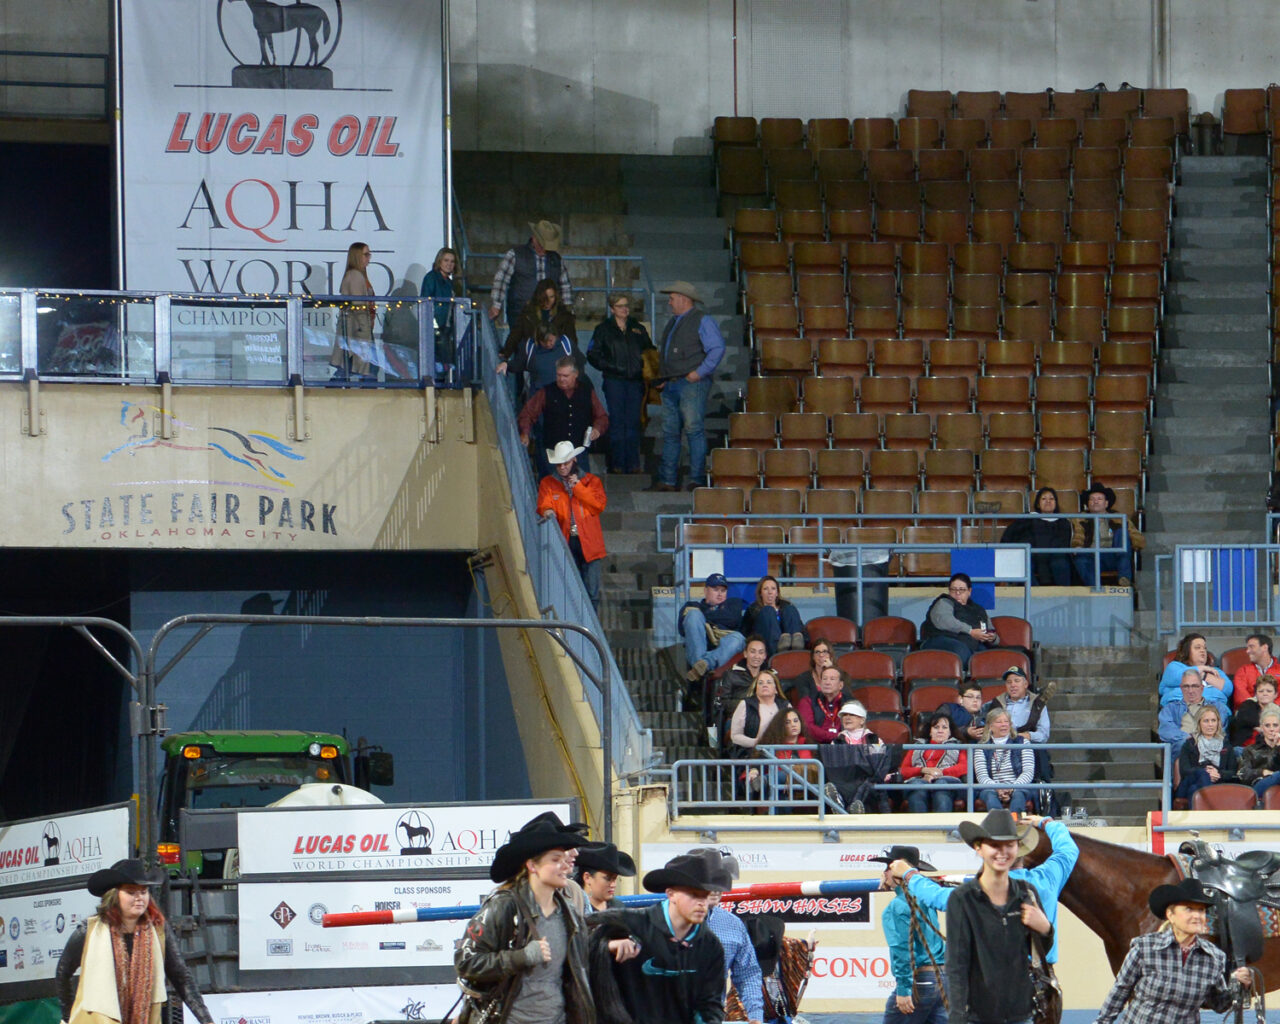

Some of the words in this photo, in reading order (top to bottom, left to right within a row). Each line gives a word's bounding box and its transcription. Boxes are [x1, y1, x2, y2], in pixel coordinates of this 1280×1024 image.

[165, 112, 319, 156] LUCAS
[327, 115, 400, 156] OIL
[177, 178, 394, 243] AQHA
[177, 310, 332, 328] CHAMPIONHIP
[61, 493, 154, 535] STATE
[170, 492, 241, 524] FAIR
[258, 495, 338, 537] PARK
[100, 527, 232, 541] OKLAHOMA
[244, 529, 299, 542] CITY
[63, 836, 102, 863] AQHA
[293, 834, 356, 854] LUCAS
[360, 833, 390, 852] OIL
[0, 848, 24, 869] UCAS
[25, 845, 39, 865] OIL
[293, 860, 346, 870] WORLD
[352, 855, 471, 869] CHAMPIONSHIP
[478, 854, 494, 865] SH
[737, 854, 768, 864] AQHA
[840, 854, 865, 862] LUCAS
[0, 873, 19, 886] ORLD
[394, 886, 415, 895] CLASS
[415, 885, 452, 895] SPONSORS
[736, 898, 793, 914] SHOW
[793, 897, 861, 915] HORSES
[811, 957, 889, 978] CONO
